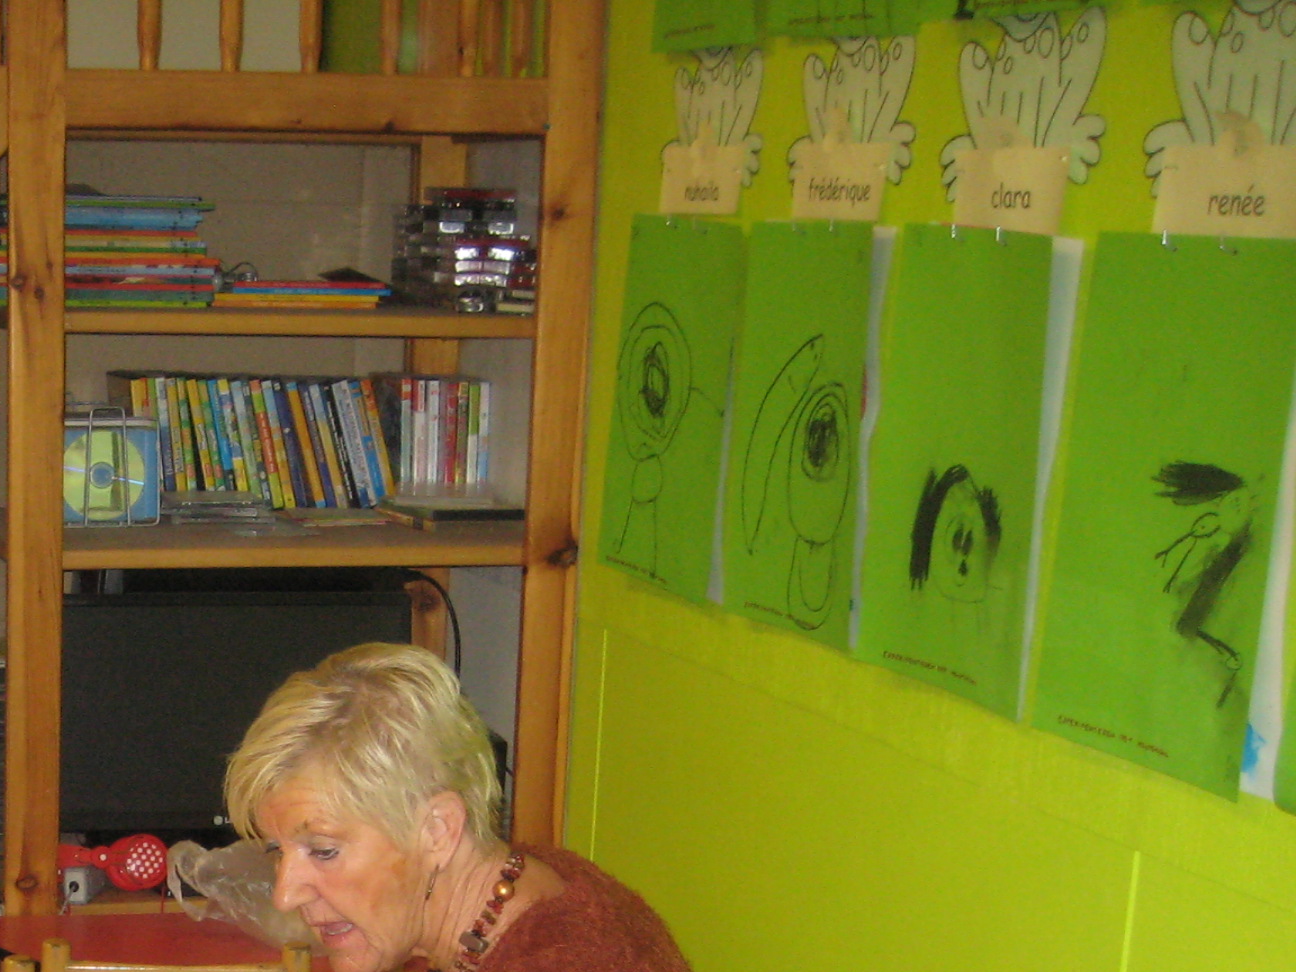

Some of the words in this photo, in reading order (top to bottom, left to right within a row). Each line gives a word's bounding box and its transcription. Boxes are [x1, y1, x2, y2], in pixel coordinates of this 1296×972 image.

[808, 177, 871, 208] frédérique
[991, 182, 1031, 209] clara
[1207, 184, 1265, 216] renée
